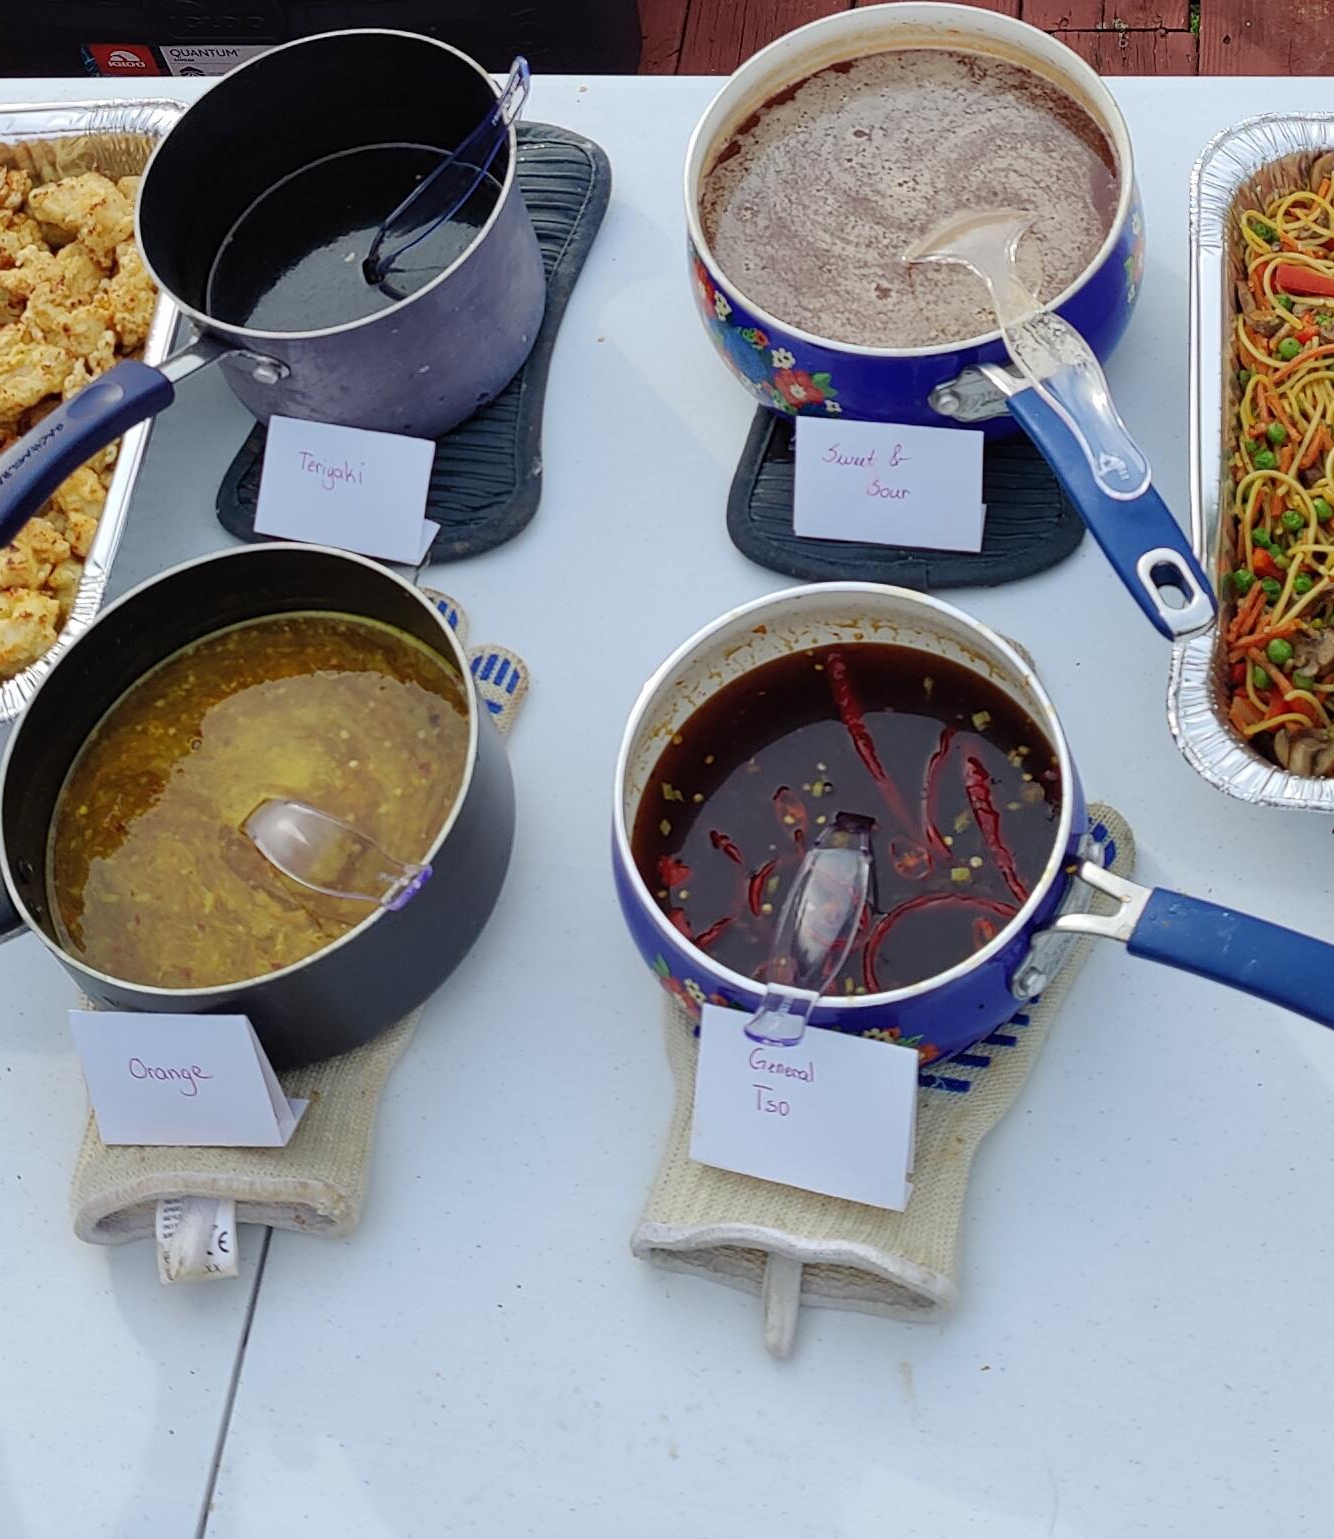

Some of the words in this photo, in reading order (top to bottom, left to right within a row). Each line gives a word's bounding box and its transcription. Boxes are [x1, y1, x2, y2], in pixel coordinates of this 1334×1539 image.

[169, 48, 238, 57] QUANTUM
[298, 450, 366, 491] Teriyaki
[821, 443, 876, 467] Sweet
[889, 443, 913, 467] &
[866, 478, 912, 499] Sour
[128, 1057, 214, 1097] Orange
[749, 1046, 815, 1083] General
[751, 1083, 790, 1117] Tso
